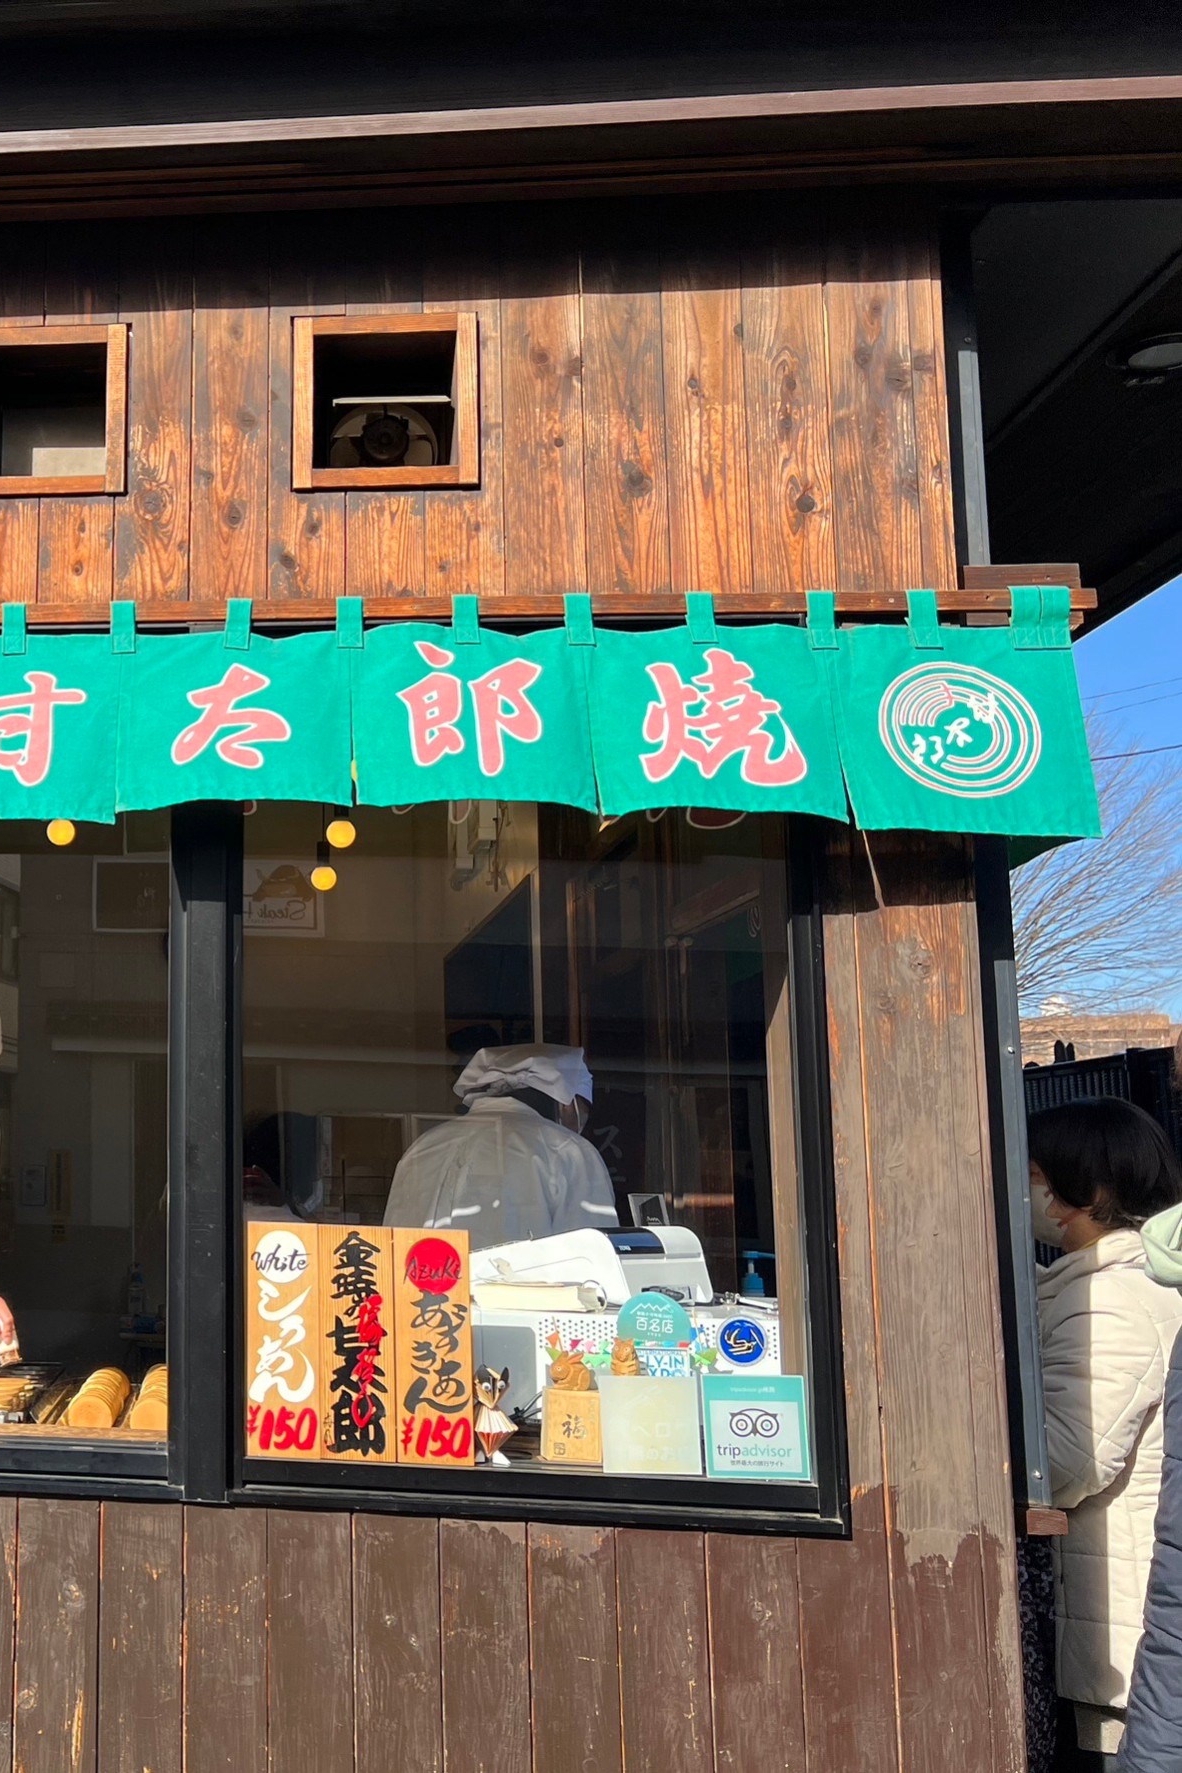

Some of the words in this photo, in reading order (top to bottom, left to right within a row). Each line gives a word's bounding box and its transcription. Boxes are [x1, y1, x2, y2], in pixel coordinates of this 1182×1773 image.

[635, 1316, 675, 1335] 百名店
[245, 1404, 319, 1452] ¥150
[400, 1414, 472, 1460] ¥150
[716, 1443, 793, 1460] tripadvisor
